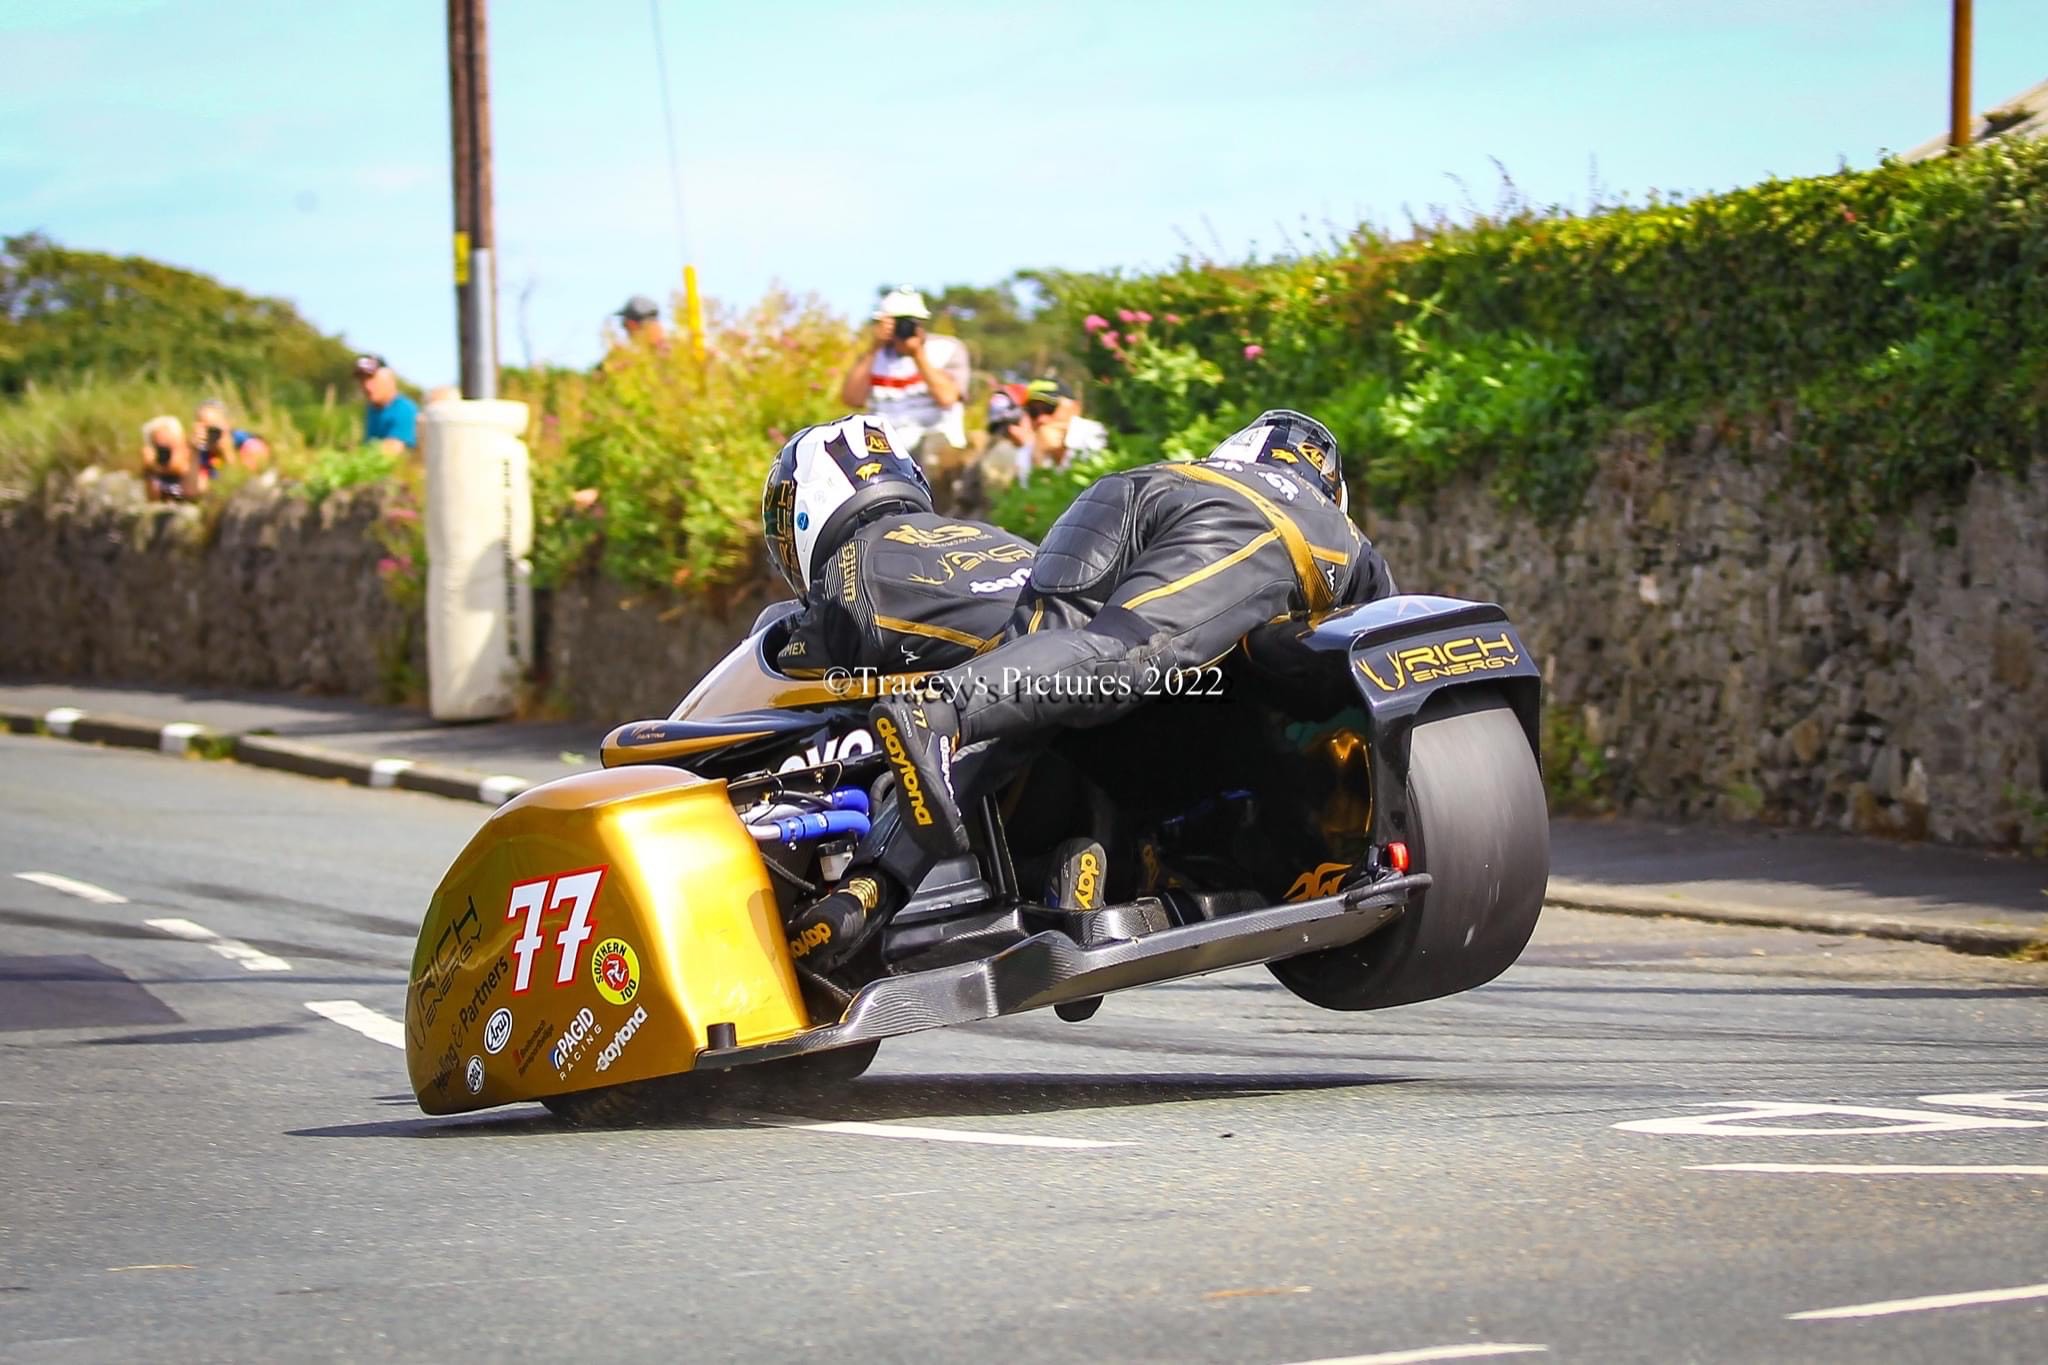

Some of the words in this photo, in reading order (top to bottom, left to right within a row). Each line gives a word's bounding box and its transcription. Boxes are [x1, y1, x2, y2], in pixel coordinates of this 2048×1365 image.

[1399, 632, 1515, 672] RICH
[1411, 653, 1520, 683] ENERGY
[876, 717, 934, 826] daytona
[507, 866, 606, 995] 77
[593, 941, 628, 984] SOUTHERN
[619, 978, 637, 1001] 100
[459, 954, 510, 1033] Partners
[557, 1007, 594, 1059] PAGID
[559, 1023, 602, 1081] RACING
[596, 1005, 649, 1073] daytona
